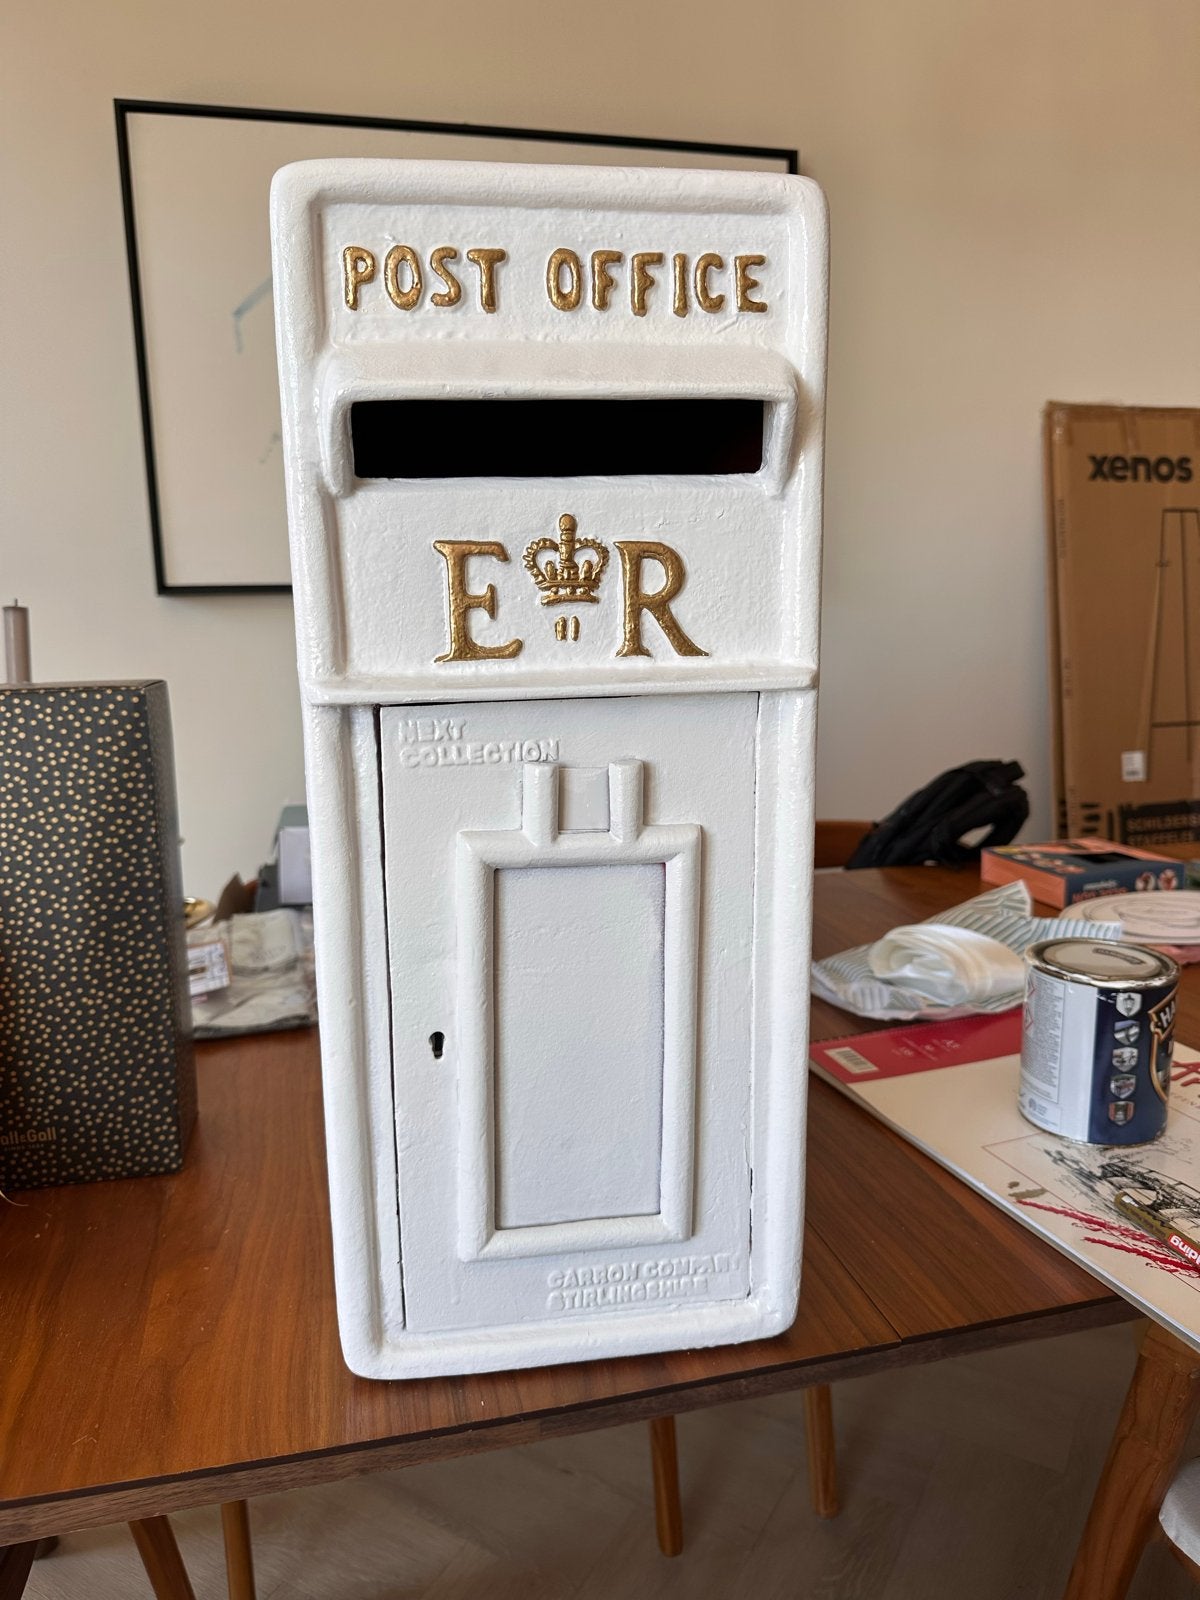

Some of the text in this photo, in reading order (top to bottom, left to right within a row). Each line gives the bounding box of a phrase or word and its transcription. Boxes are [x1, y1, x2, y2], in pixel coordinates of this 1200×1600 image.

[343, 245, 768, 317] POST OFFICE
[1088, 454, 1193, 483] xenos
[433, 540, 709, 662] E R
[398, 718, 468, 744] NEXT
[399, 737, 561, 768] COLLECTION
[0, 1126, 57, 1146] all&Gall
[547, 1261, 640, 1290] CARRON
[546, 1277, 709, 1312] STIRLINGSHIRE
